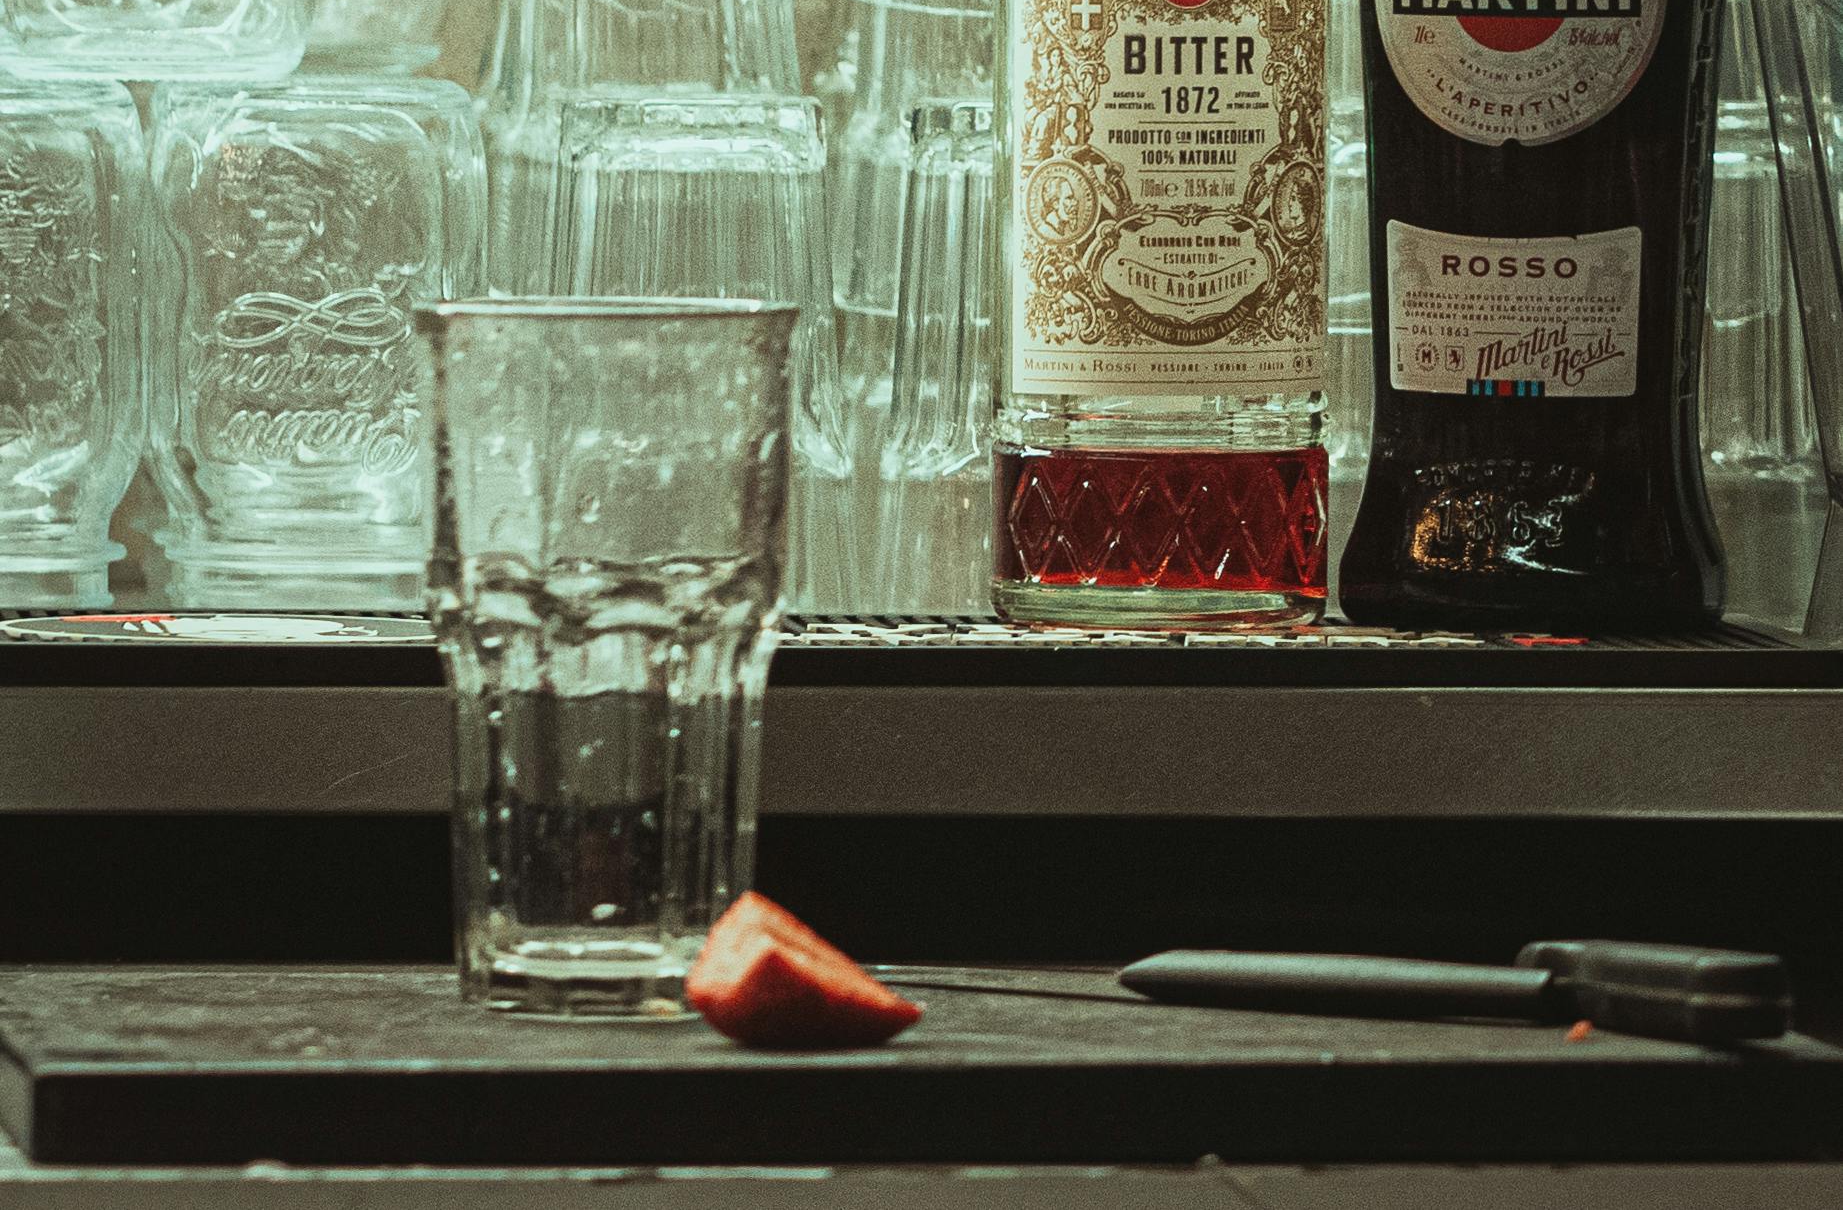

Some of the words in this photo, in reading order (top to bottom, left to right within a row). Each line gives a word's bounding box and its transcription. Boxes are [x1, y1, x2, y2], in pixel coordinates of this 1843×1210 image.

[1124, 33, 1255, 75] BITTER
[1161, 86, 1220, 114] 1872
[1435, 76, 1588, 117] L'APERITIVO
[1108, 129, 1171, 145] PRODOTTO
[1195, 129, 1265, 144] INGREDIENTI
[1141, 150, 1175, 165] 100%
[1179, 150, 1237, 165] NATURALI
[1441, 254, 1578, 279] ROSSO
[1123, 302, 1172, 339] PESSIONE
[1177, 325, 1216, 341] TORINO
[1219, 304, 1250, 332] ITALIA
[1411, 326, 1434, 336] DAL
[1440, 327, 1470, 337] 1863
[1024, 358, 1075, 372] MARTINI
[1092, 360, 1137, 373] ROSSI
[1475, 320, 1569, 380] Martini
[1541, 354, 1551, 370] e
[1552, 328, 1625, 387] Rossi
